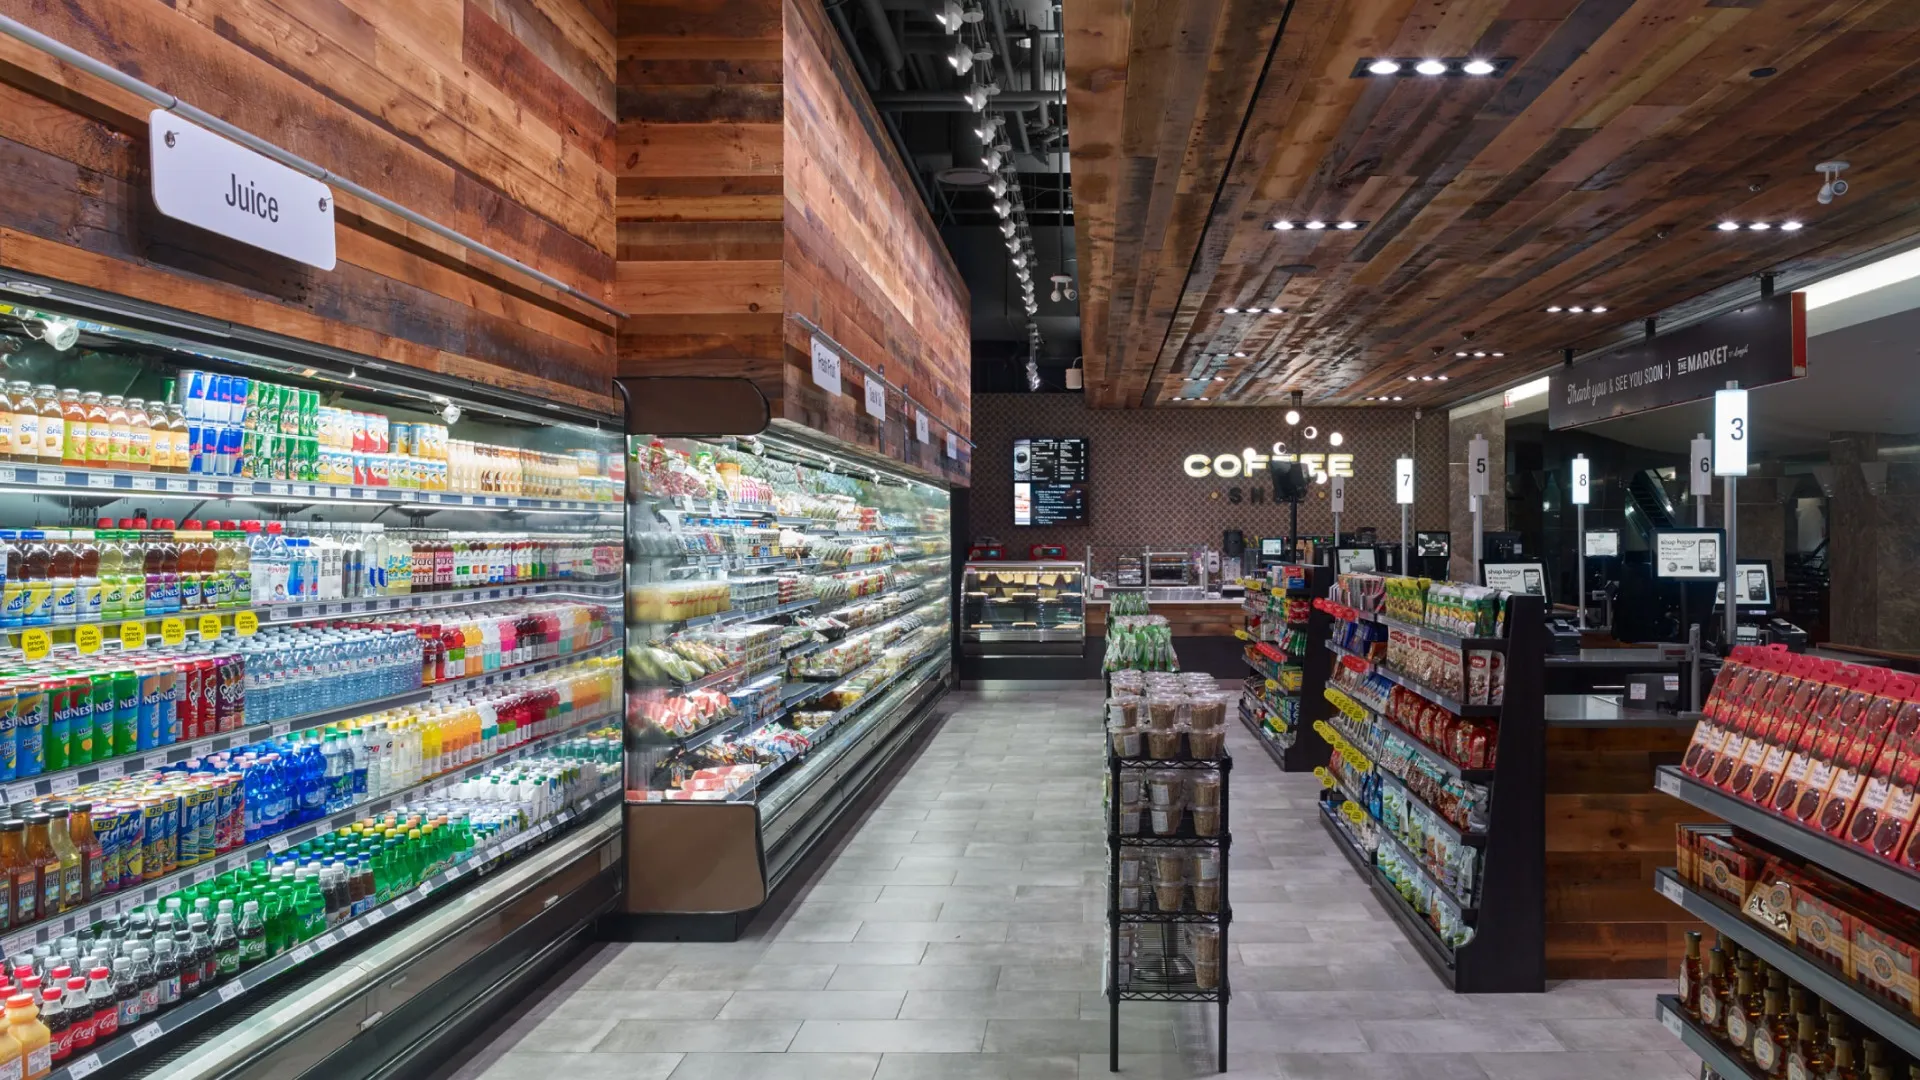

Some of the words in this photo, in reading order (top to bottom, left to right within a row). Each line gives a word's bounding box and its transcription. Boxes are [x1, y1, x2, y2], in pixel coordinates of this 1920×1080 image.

[225, 173, 279, 223] Juice
[1688, 345, 1728, 373] MARKET
[1567, 379, 1591, 405] Thank
[1591, 383, 1607, 406] you
[1609, 379, 1614, 393] &
[1615, 374, 1628, 392] SEE
[1629, 371, 1643, 388] YOU
[1644, 364, 1663, 384] SOON
[1731, 417, 1744, 440] 3
[1183, 453, 1354, 478] COFEE
[1476, 458, 1486, 473] 5
[1700, 457, 1709, 472] 6
[1403, 474, 1411, 486] 7
[1579, 474, 1587, 486] 8
[1335, 488, 1342, 499] 9
[1677, 538, 1697, 546] happy
[1503, 568, 1521, 576] happy
